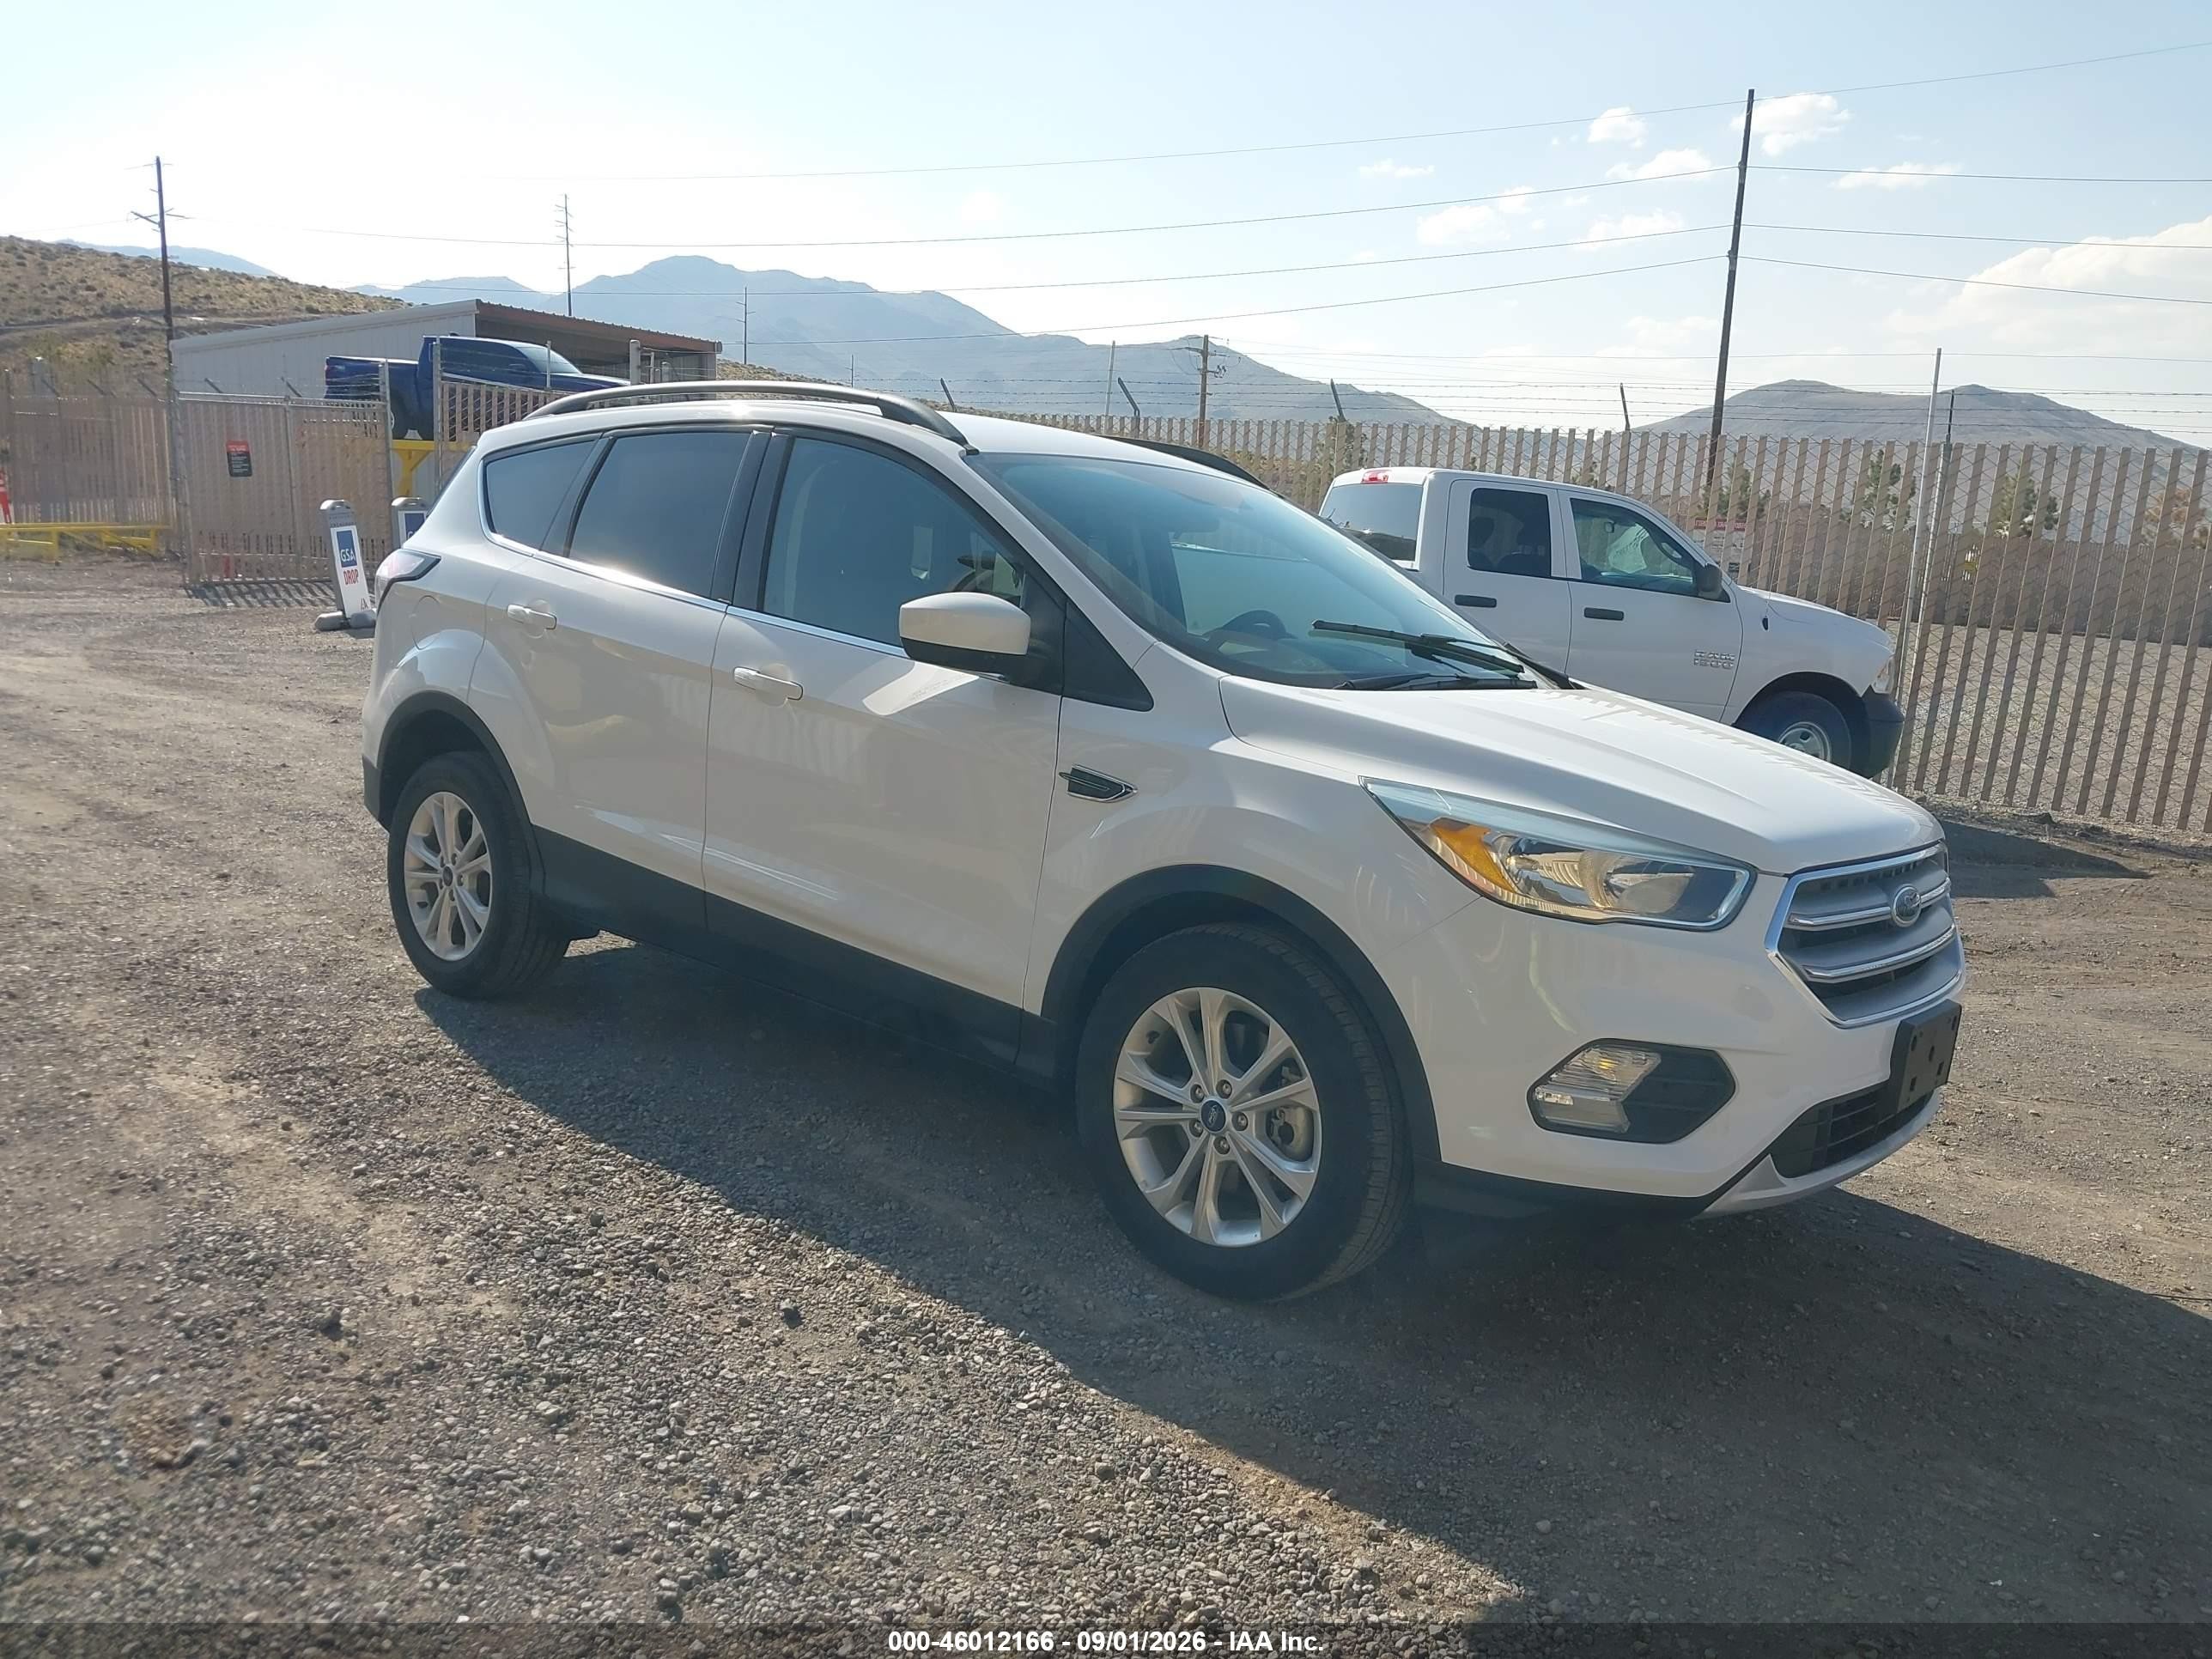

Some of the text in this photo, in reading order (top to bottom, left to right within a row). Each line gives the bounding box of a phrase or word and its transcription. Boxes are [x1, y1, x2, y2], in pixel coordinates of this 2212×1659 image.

[340, 549, 356, 562] GSA
[343, 569, 358, 585] DROP
[1694, 651, 1735, 661] RAM
[1694, 659, 1735, 669] 1500
